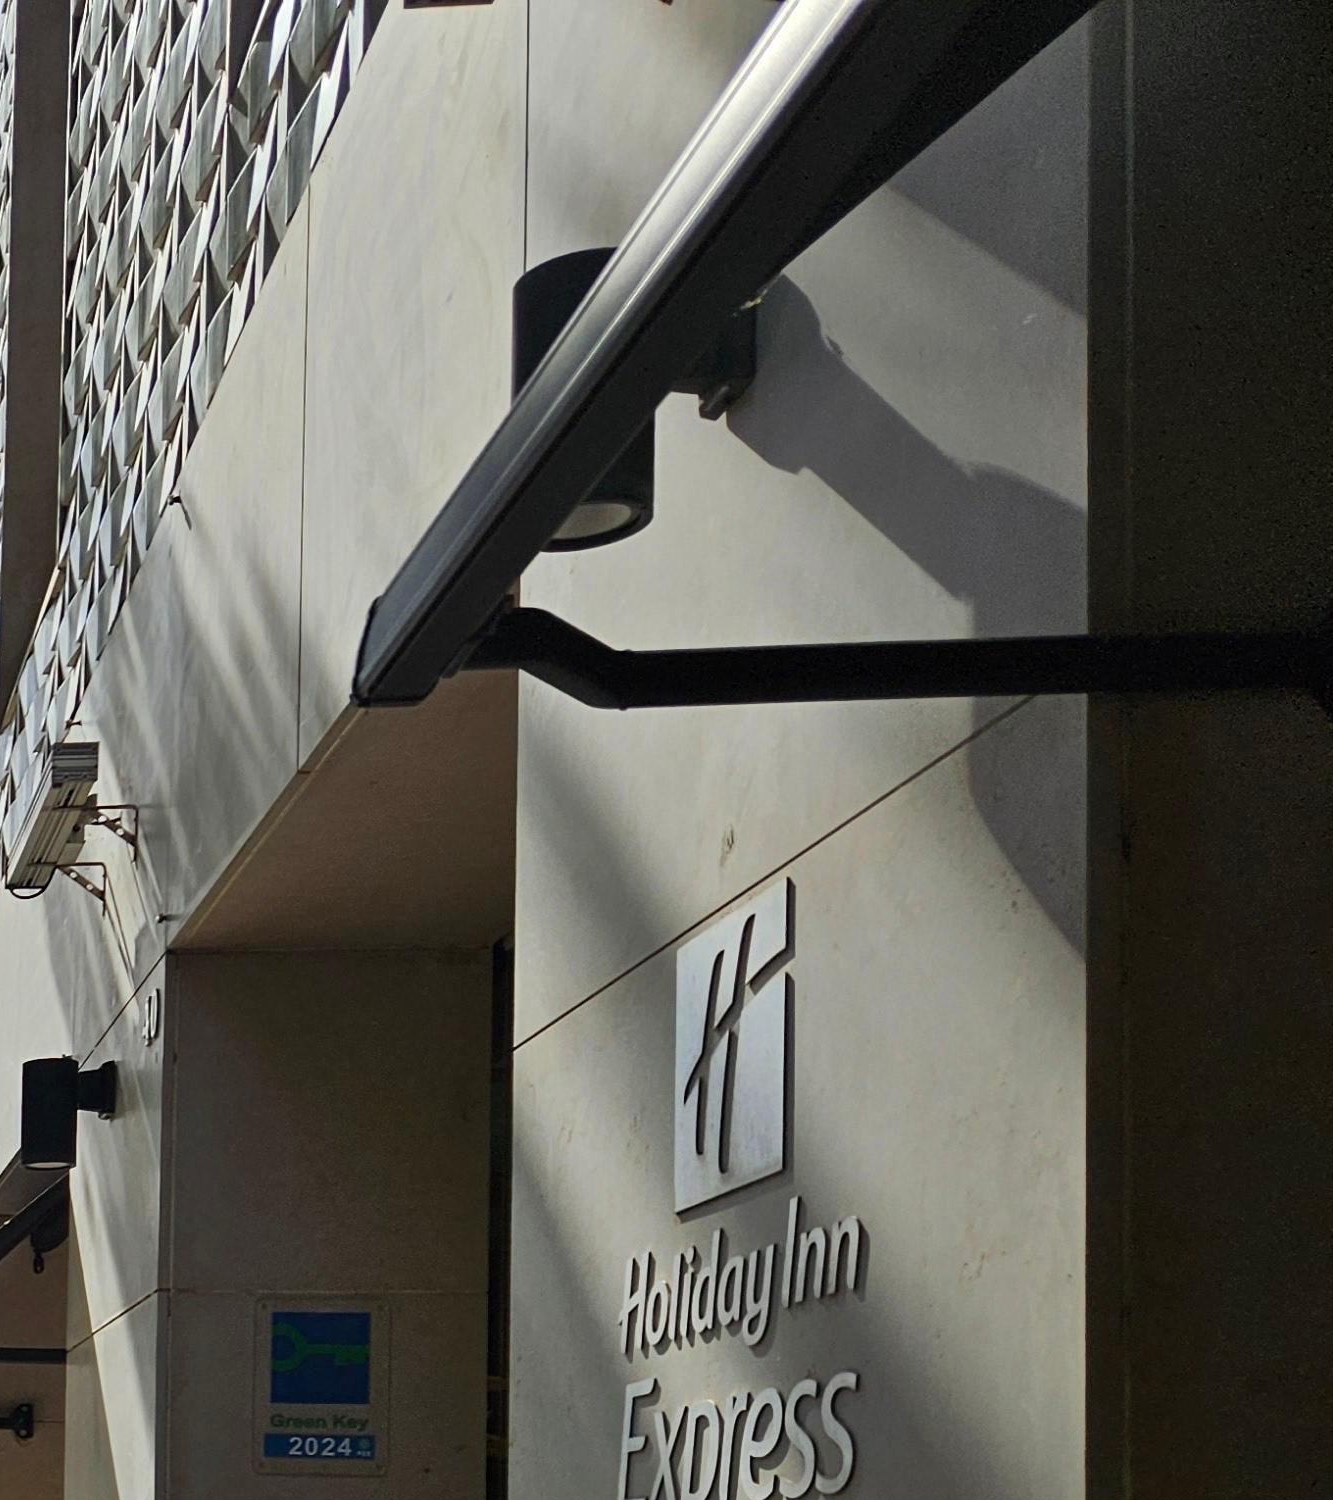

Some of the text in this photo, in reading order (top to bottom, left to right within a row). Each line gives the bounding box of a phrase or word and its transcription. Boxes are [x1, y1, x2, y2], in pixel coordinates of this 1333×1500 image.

[618, 1196, 861, 1354] Holiday Inn
[288, 1436, 352, 1456] 2024
